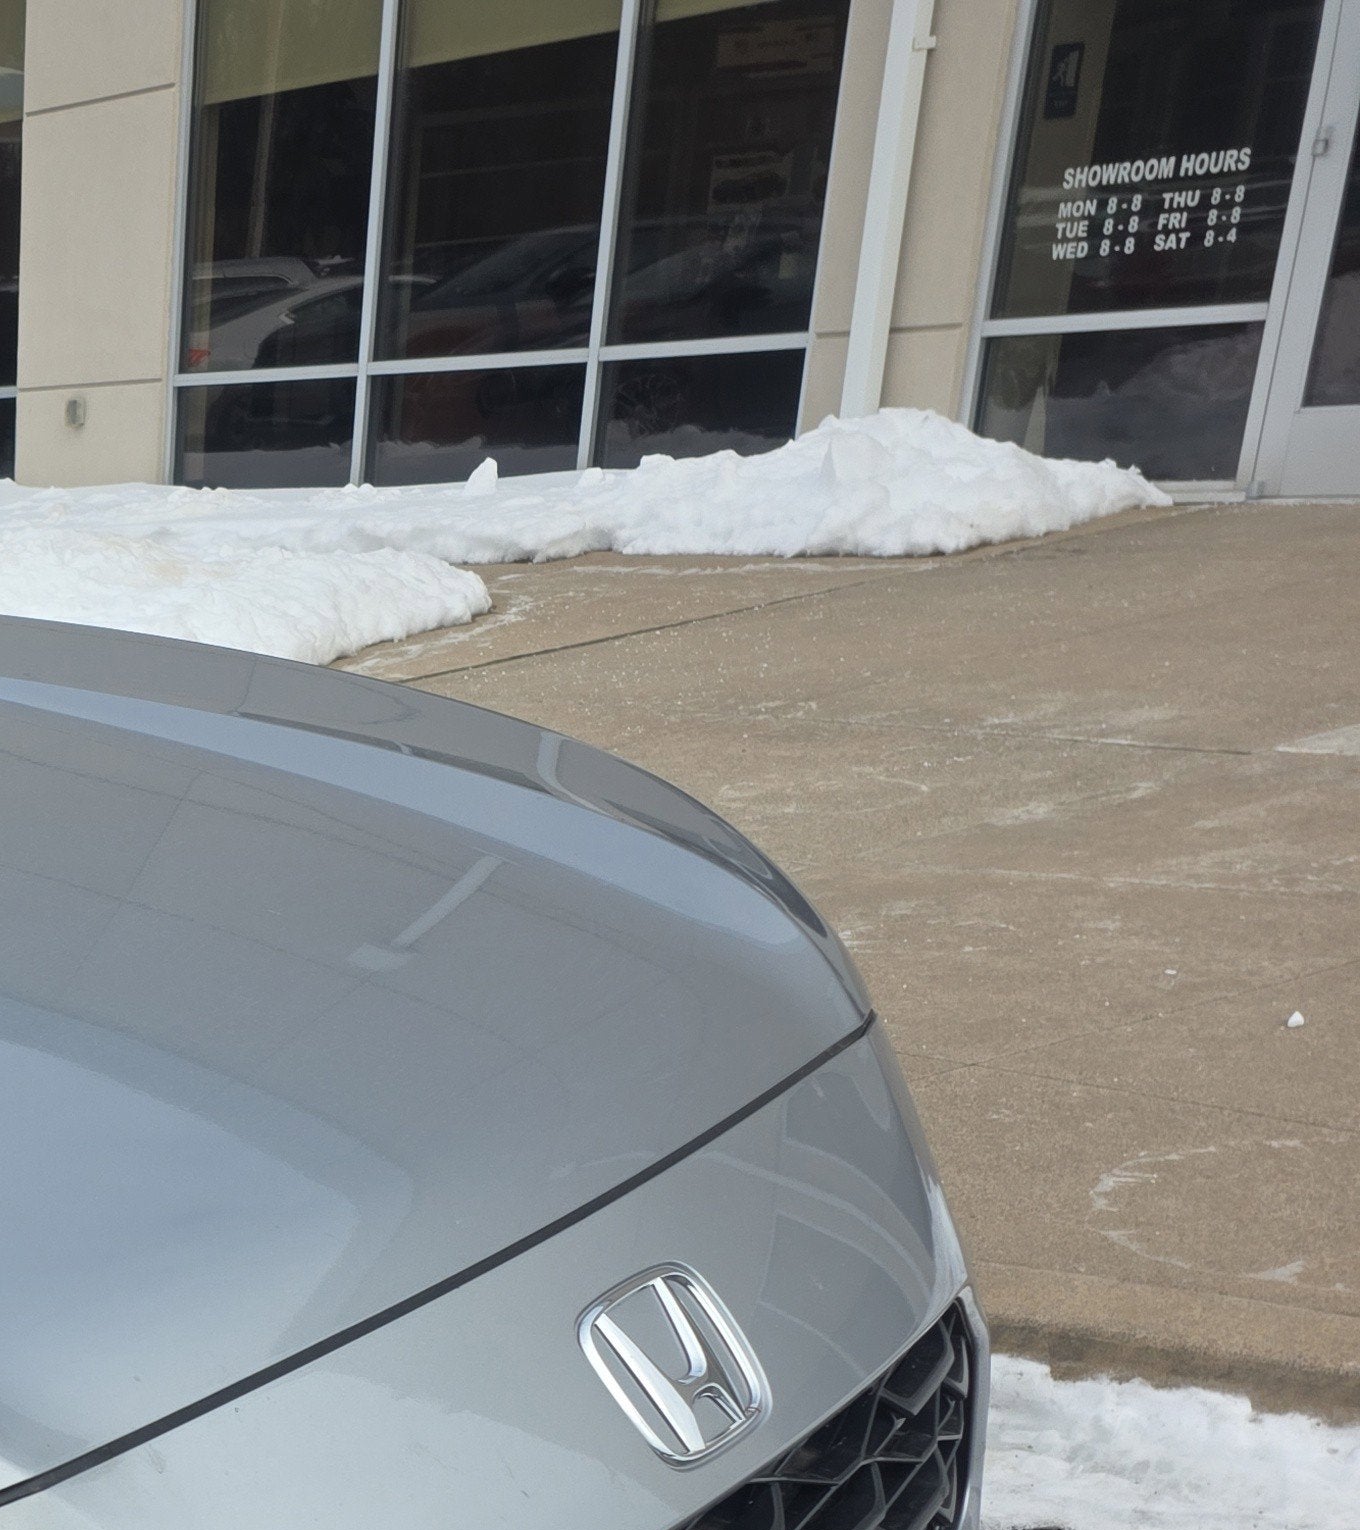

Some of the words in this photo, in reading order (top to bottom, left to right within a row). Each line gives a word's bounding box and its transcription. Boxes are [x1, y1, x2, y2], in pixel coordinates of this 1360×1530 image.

[1062, 156, 1176, 190] SHOWROOM
[1180, 147, 1252, 178] HOURS
[1058, 199, 1098, 219] MON
[1162, 189, 1201, 209] THU
[1055, 220, 1089, 240] TUE
[1157, 211, 1188, 231] FRI
[1052, 241, 1089, 261] WED
[1153, 231, 1191, 252] SAT
